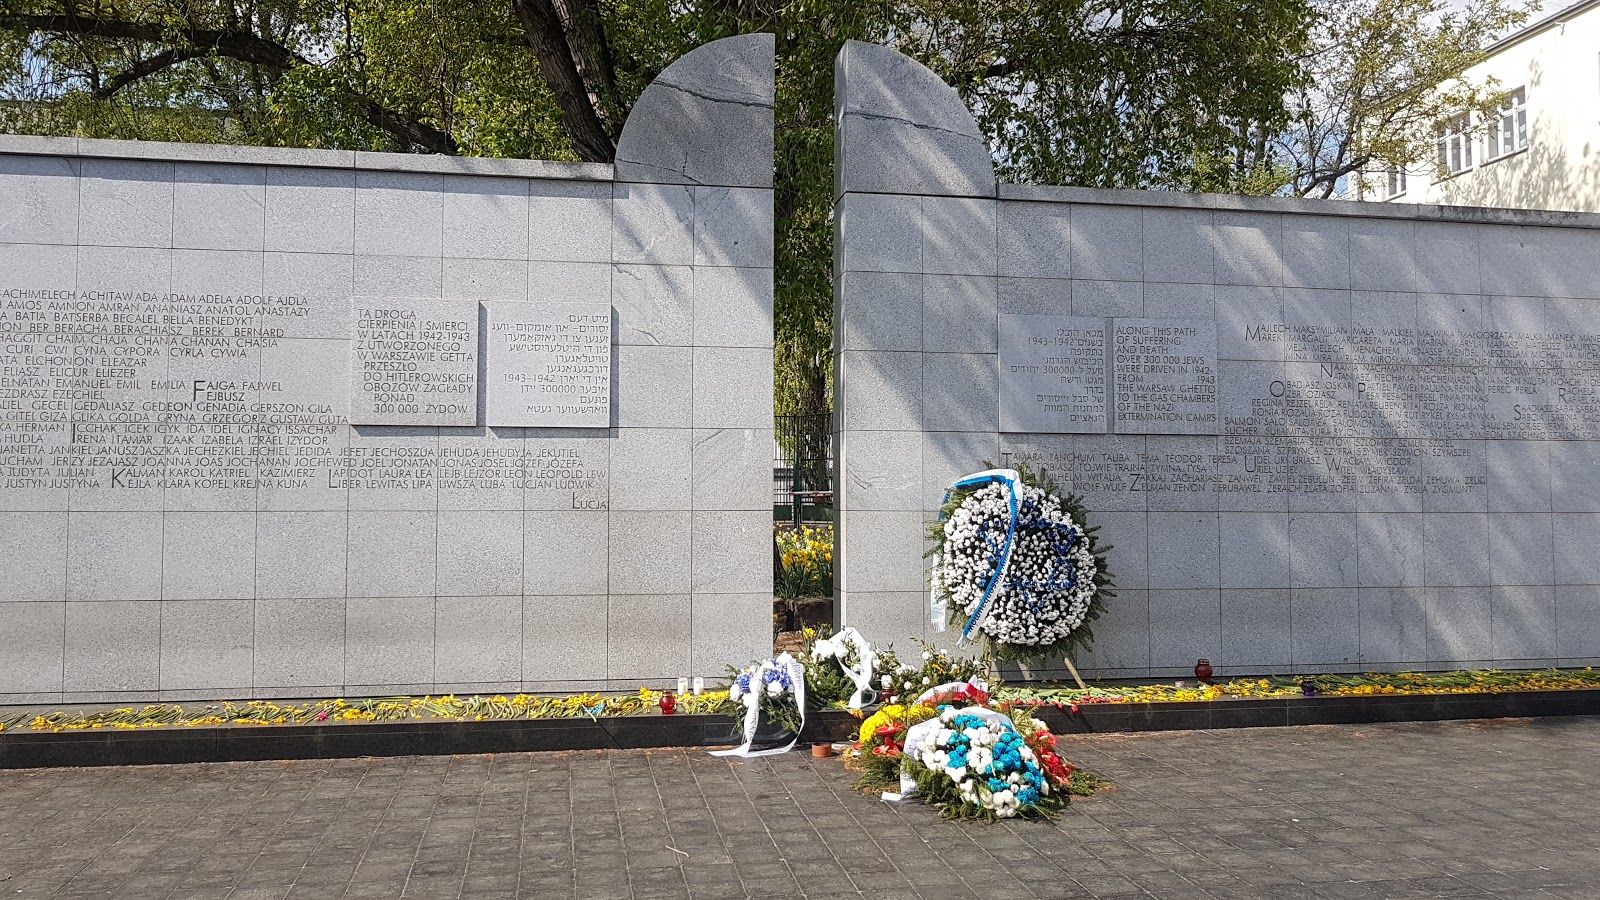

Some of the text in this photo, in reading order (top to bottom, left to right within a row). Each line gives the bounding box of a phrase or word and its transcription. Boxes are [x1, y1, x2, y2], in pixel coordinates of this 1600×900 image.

[3, 289, 75, 300] ACHIMELECH
[162, 293, 196, 303] ADAM
[199, 294, 233, 304] ADELA
[236, 295, 273, 305] ADOLF
[276, 296, 309, 306] AJDLA
[7, 300, 310, 317] AMOS AMNON ANANIASZ ANATOL ANASTAZY
[15, 312, 46, 321] BATIA
[113, 313, 159, 324] BECALEL
[198, 316, 254, 326] BENEDYKT
[358, 319, 416, 330] CIERPIENIA
[54, 323, 284, 337] BERACHA BERACHIASZ BEREK BERNARD
[358, 330, 369, 339] W
[372, 330, 414, 340] LATACH
[1116, 326, 1196, 337] ALONG THIS PATH
[46, 334, 85, 344] CHAIM
[90, 335, 128, 345] CHAJA
[181, 337, 230, 347] CHANAN
[1116, 335, 1181, 345] OF SUFFERING
[357, 340, 461, 352] Z UTWORZONEGO
[1116, 345, 1169, 354] AND DEATH
[114, 346, 160, 356] CYPORA
[170, 348, 205, 358] CYRLA
[211, 348, 247, 358] CYWIA
[357, 351, 474, 362] W WARSZAWIE GETTA
[25, 356, 147, 367] ELCHONON ELEAZAR
[1116, 354, 1141, 364] OVER
[1182, 356, 1205, 365] JEWS
[4, 367, 136, 378] ELIASZ ELIEZER
[1116, 364, 1141, 373] WERE
[1143, 364, 1176, 374] DRIVEN
[1178, 365, 1188, 374] IN
[363, 372, 474, 383] DO HITLEROWSKICH
[1117, 373, 1144, 383] FROM
[56, 378, 112, 389] EMANUEL
[1116, 383, 1216, 394] THE WARSAW GHETTO
[53, 389, 105, 400] EZECHIEL
[373, 393, 415, 403] PONAD
[1117, 392, 1130, 402] TO
[1149, 393, 1168, 402] GAS
[1169, 393, 1216, 404] CHAMBERS
[74, 401, 304, 413] GEDALIASZ GENADIA GERSZON
[373, 404, 394, 414] 300
[398, 404, 418, 414] 000
[1117, 402, 1174, 412] OF THE NAZI
[202, 413, 349, 425] GRZEGORZ GUTA
[1117, 412, 1217, 422] EXTERMINATION CAMPS
[4, 434, 244, 445] HUDLA IZABELA
[51, 457, 86, 467] JERZY
[360, 458, 387, 468] JOEL
[169, 468, 583, 479] KAROL LAURA LEOPOLD
[4, 478, 47, 489] JUSTYN
[277, 479, 308, 489] KUNA
